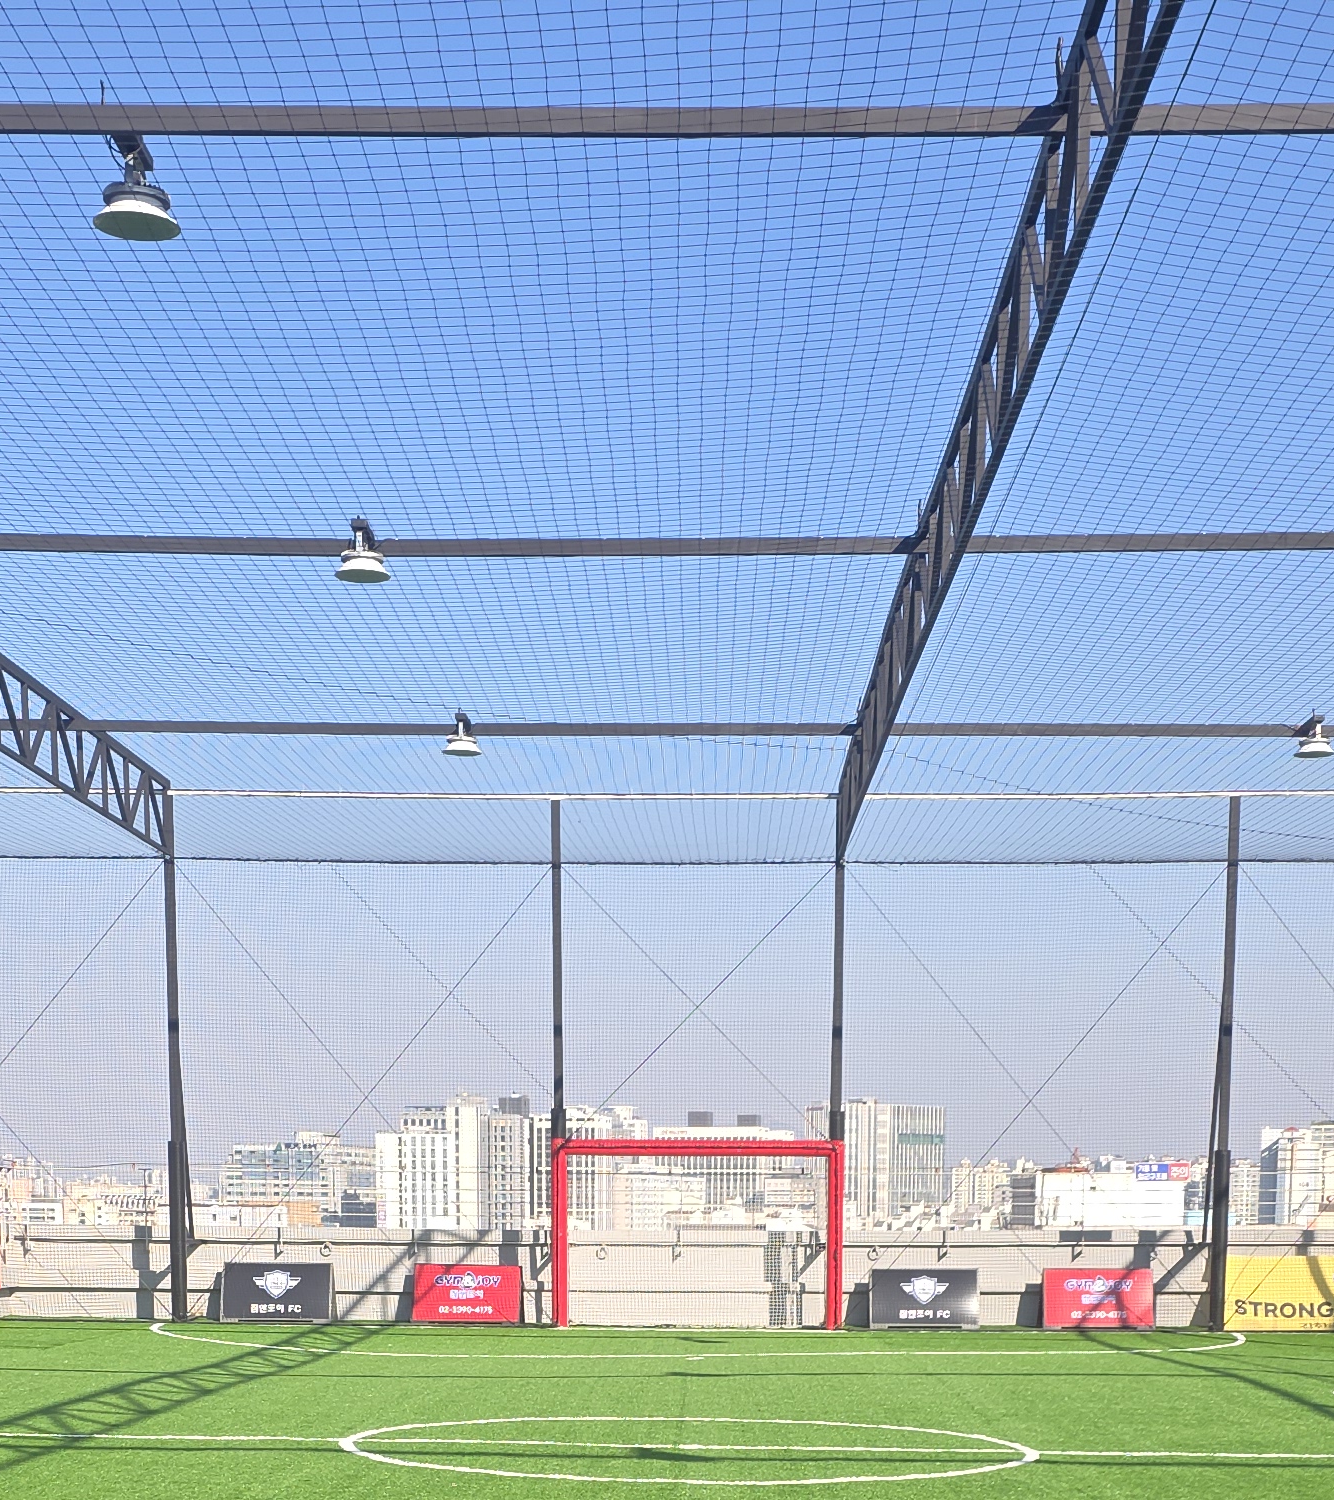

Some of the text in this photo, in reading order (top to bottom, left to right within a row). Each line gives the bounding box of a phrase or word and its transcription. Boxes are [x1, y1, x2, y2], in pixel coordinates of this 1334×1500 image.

[288, 1304, 302, 1313] FC
[1234, 1299, 1334, 1319] STRONG
[936, 1310, 951, 1319] FC
